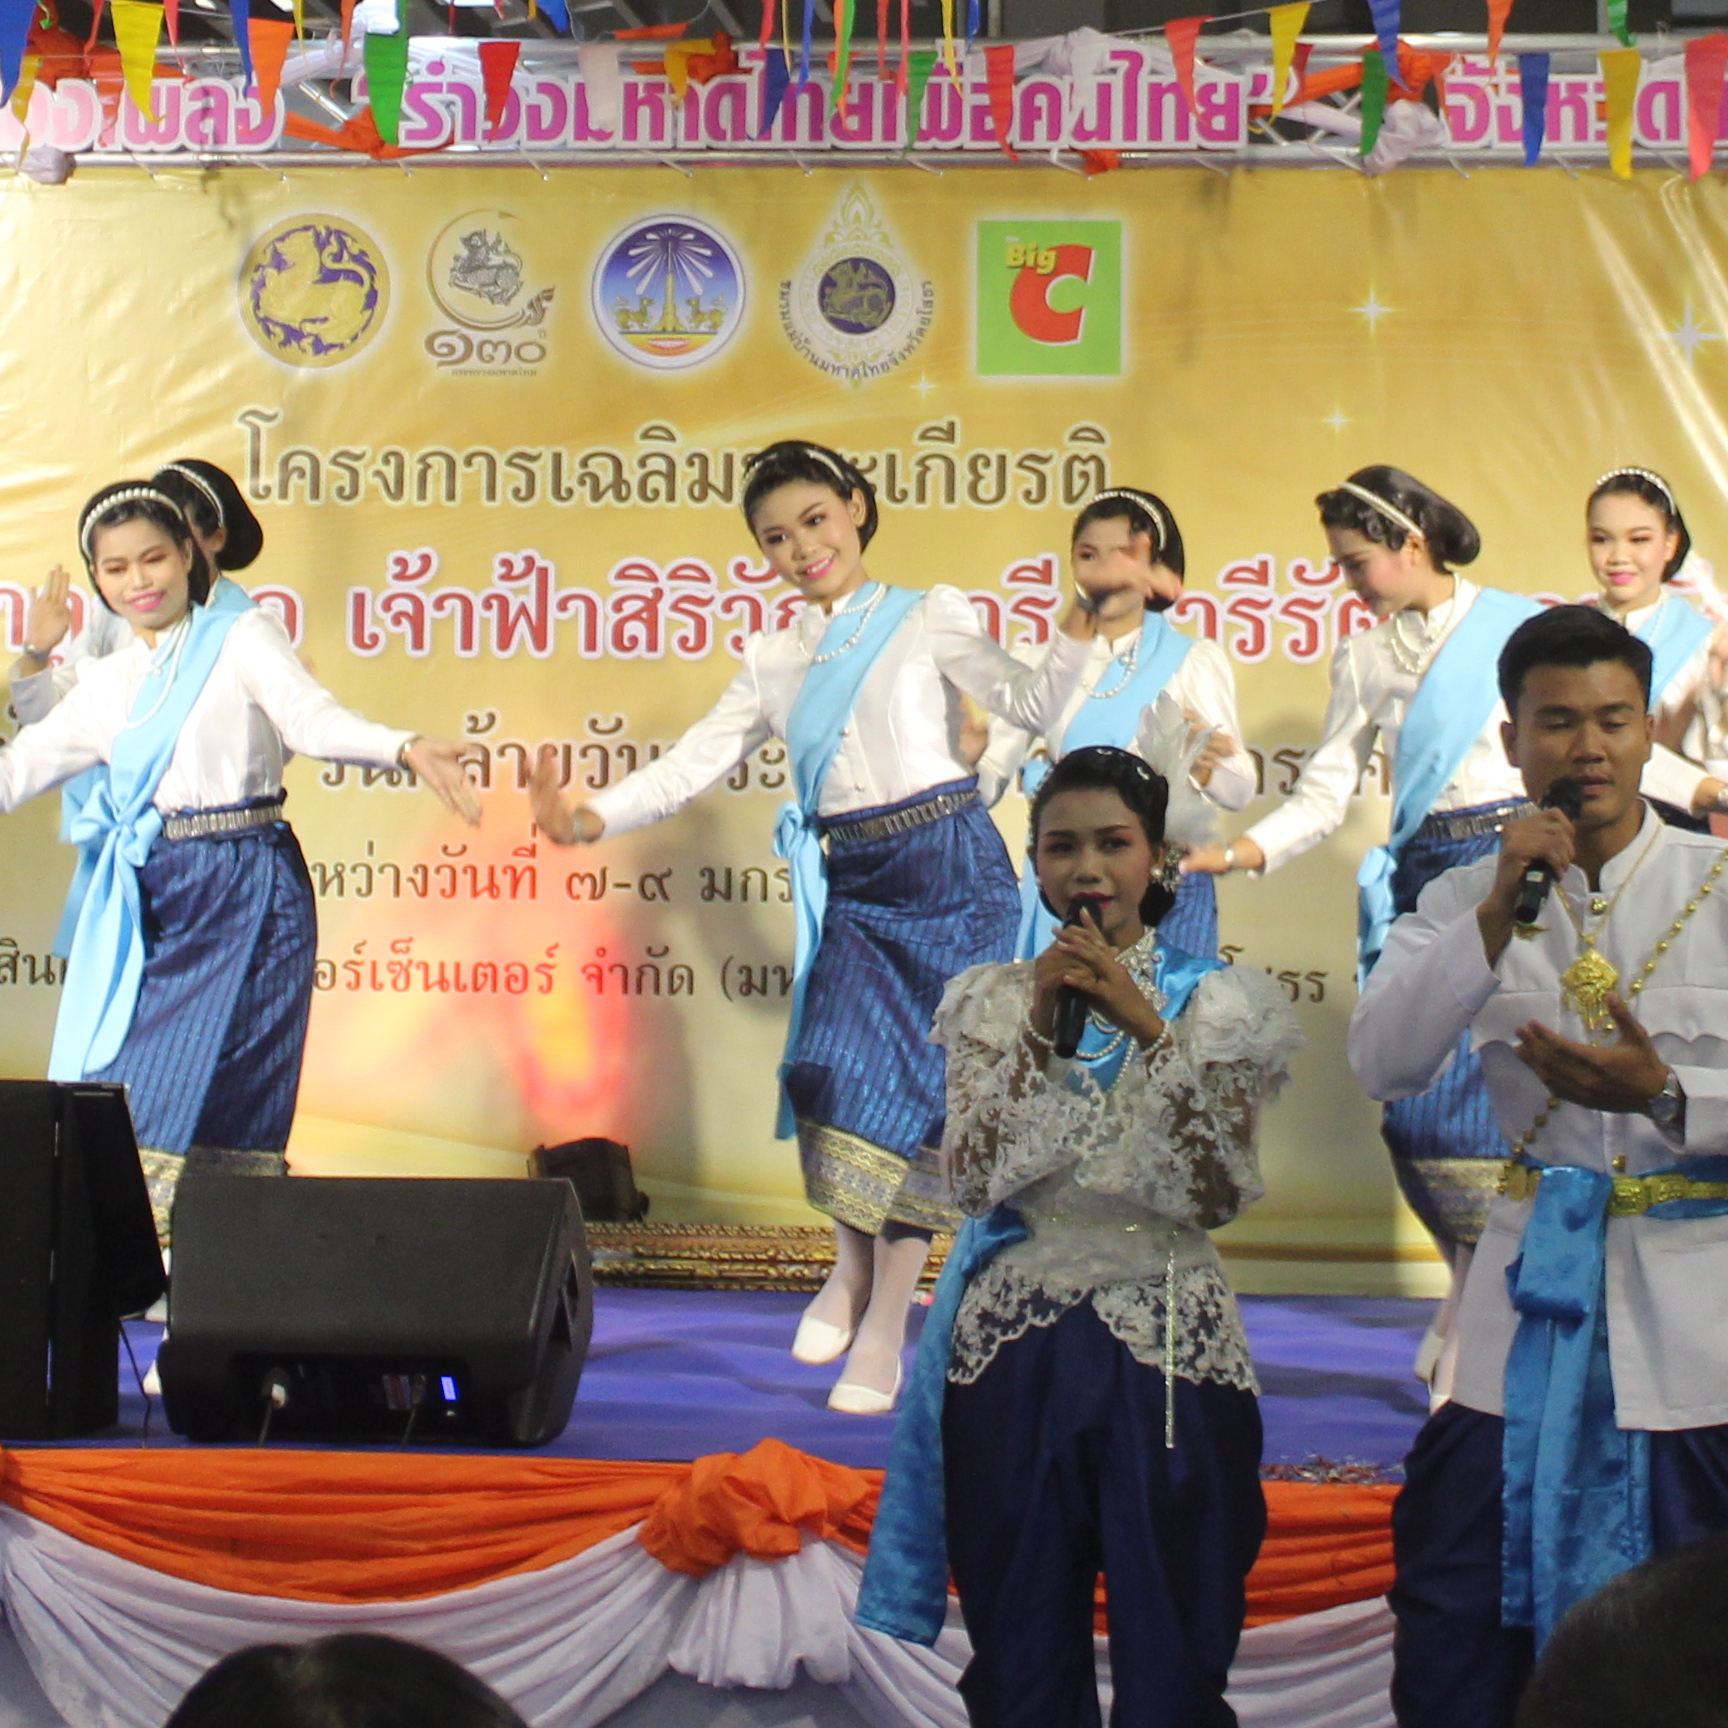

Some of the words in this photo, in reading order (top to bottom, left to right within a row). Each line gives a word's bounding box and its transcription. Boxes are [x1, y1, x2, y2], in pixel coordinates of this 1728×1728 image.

[1006, 242, 1058, 276] Big
[1009, 244, 1096, 346] C
[581, 945, 695, 997] จำกัด
